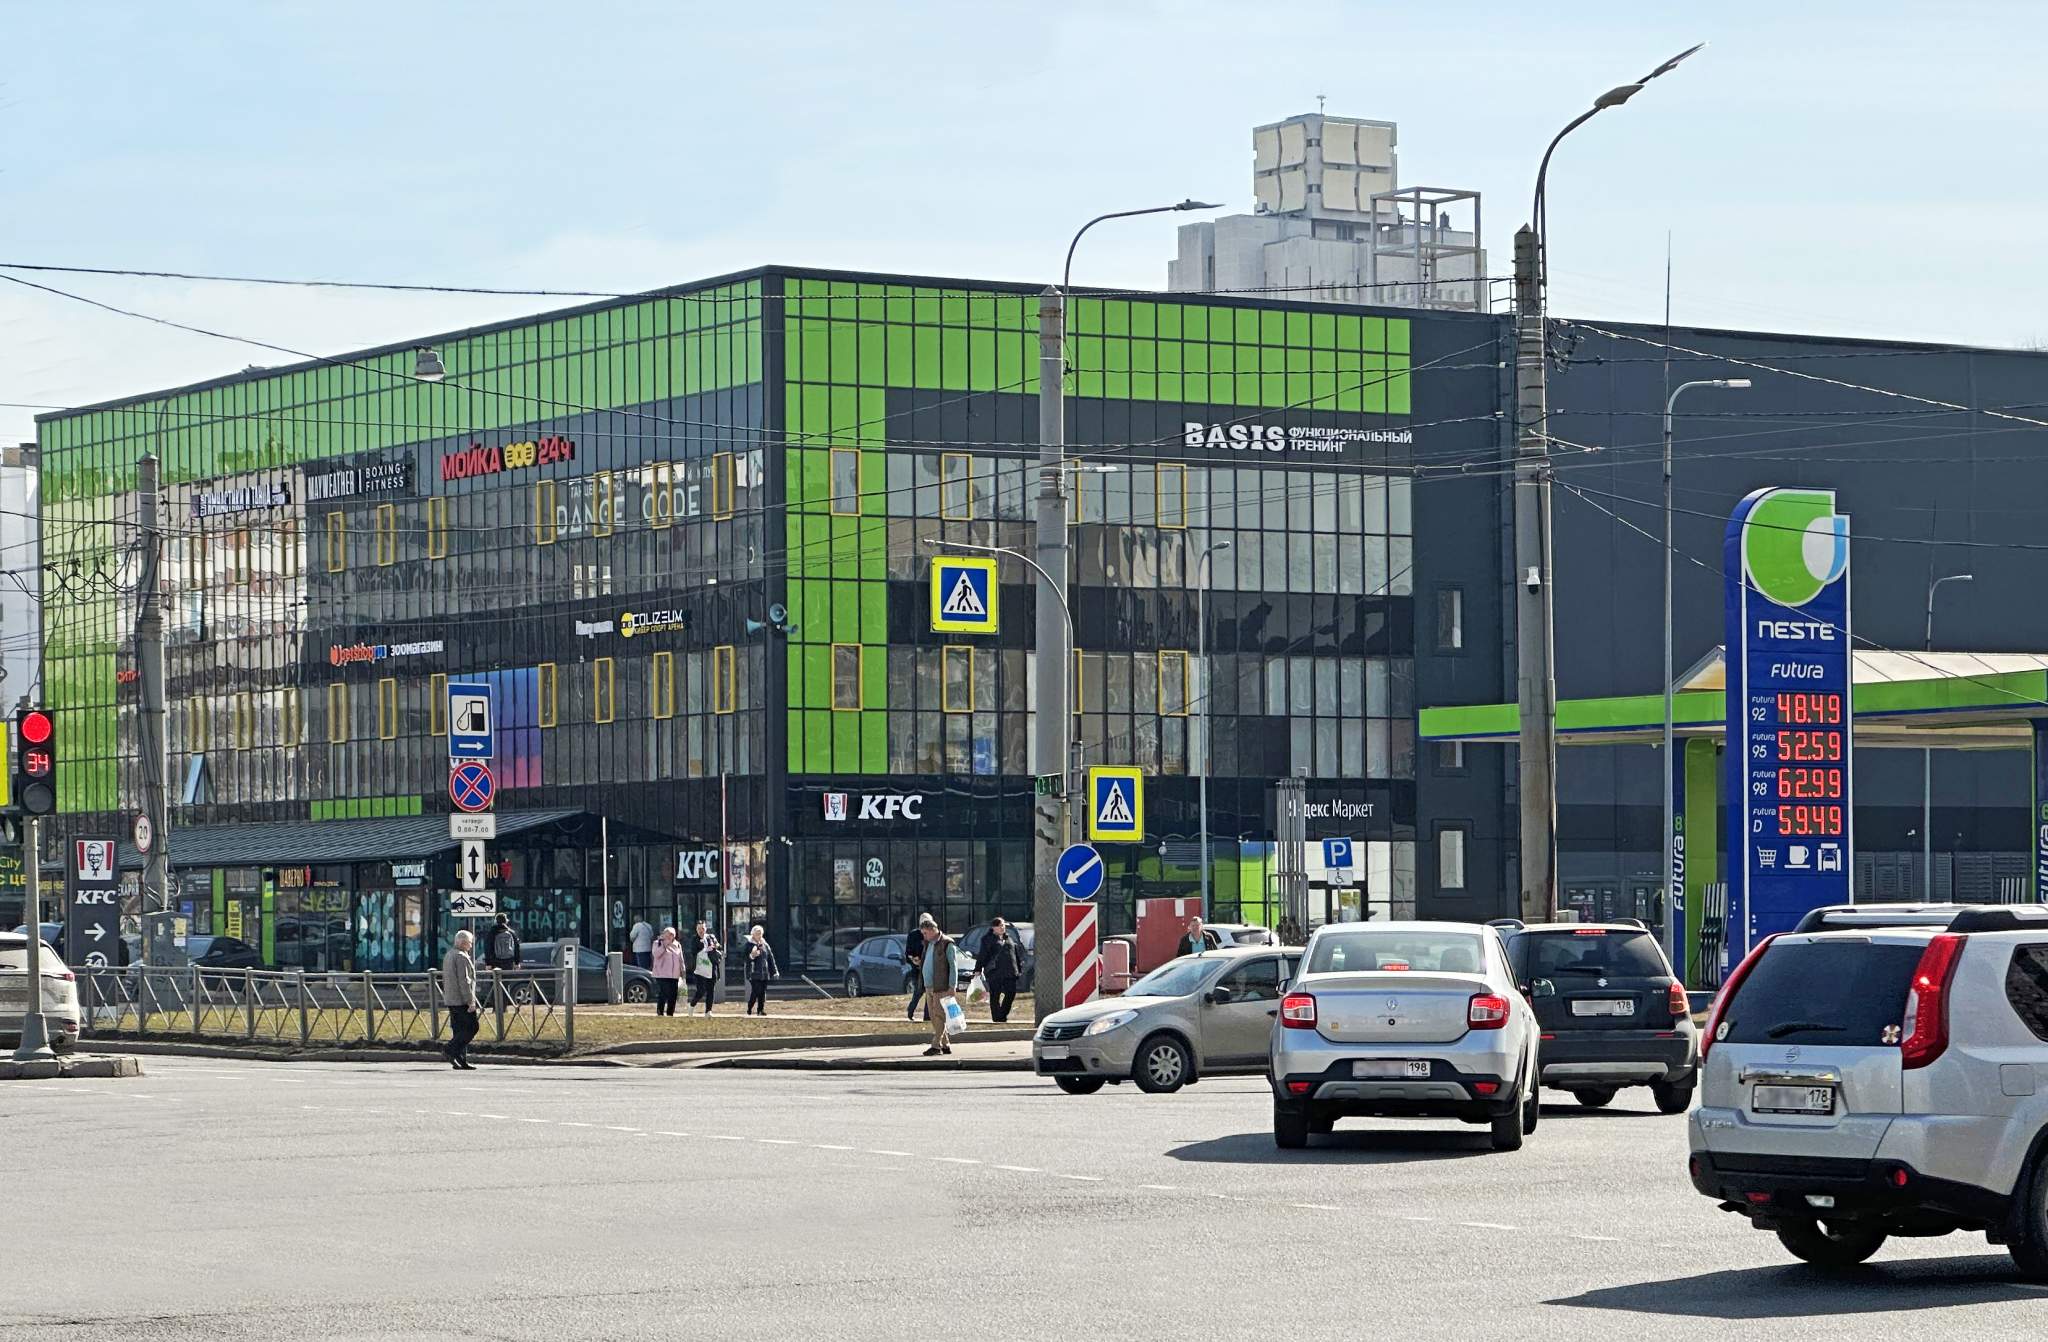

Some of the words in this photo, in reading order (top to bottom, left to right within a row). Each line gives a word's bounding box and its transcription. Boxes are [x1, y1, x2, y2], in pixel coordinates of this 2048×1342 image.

[1184, 422, 1285, 451] BASIS
[1287, 426, 1413, 444] ФУНКЦИОНАЛЬНЫЙ
[1289, 439, 1346, 453] ТРЕНИНГ
[440, 443, 500, 480] МОЙКА
[308, 470, 355, 500] MAYWEATHER
[365, 476, 404, 492] FITNESS
[643, 486, 700, 520] CODE
[633, 610, 683, 627] COLIZEUM
[1758, 620, 1835, 640] NESTE
[390, 640, 444, 657] зоомагазин
[1751, 707, 1766, 721] 92
[1777, 693, 1841, 723] 48.49
[1752, 745, 1768, 758] 95
[1777, 730, 1841, 760] 52.59
[28, 753, 49, 772] 34
[1752, 782, 1768, 796] 98
[1778, 767, 1841, 798] 62.99
[858, 794, 923, 820] KFC
[1288, 799, 1330, 819] Ядекс
[1332, 798, 1375, 821] Маркет
[1753, 819, 1763, 833] D
[1778, 804, 1842, 835] 59.49
[138, 826, 148, 840] 20
[1330, 841, 1347, 866] P
[677, 849, 719, 879] KFC
[867, 861, 881, 874] 24
[863, 877, 886, 888] ЧАСА
[75, 889, 117, 905] KFC
[1616, 1001, 1631, 1009] 178
[1408, 1062, 1427, 1072] 198
[1808, 1089, 1828, 1103] 178
